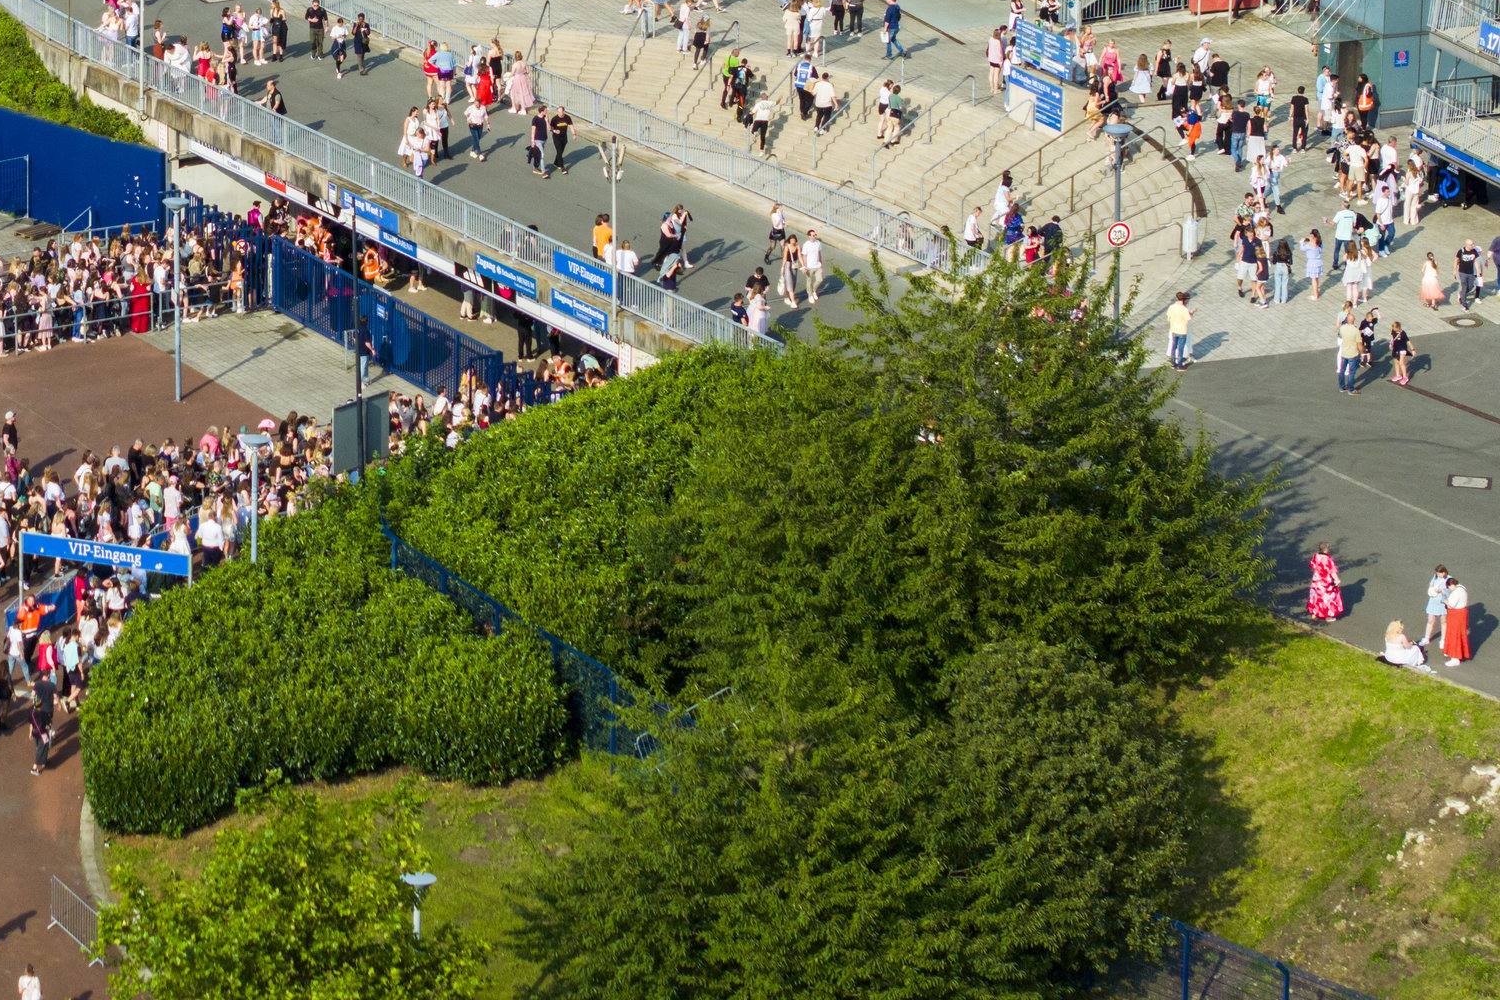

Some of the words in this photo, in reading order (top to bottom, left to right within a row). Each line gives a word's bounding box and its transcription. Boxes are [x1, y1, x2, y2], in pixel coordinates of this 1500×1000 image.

[1487, 32, 1499, 50] 17
[365, 202, 378, 216] West
[476, 255, 496, 274] Zugang
[568, 260, 605, 288] VIP-Eingang
[68, 541, 142, 567] VIP-Eingang
